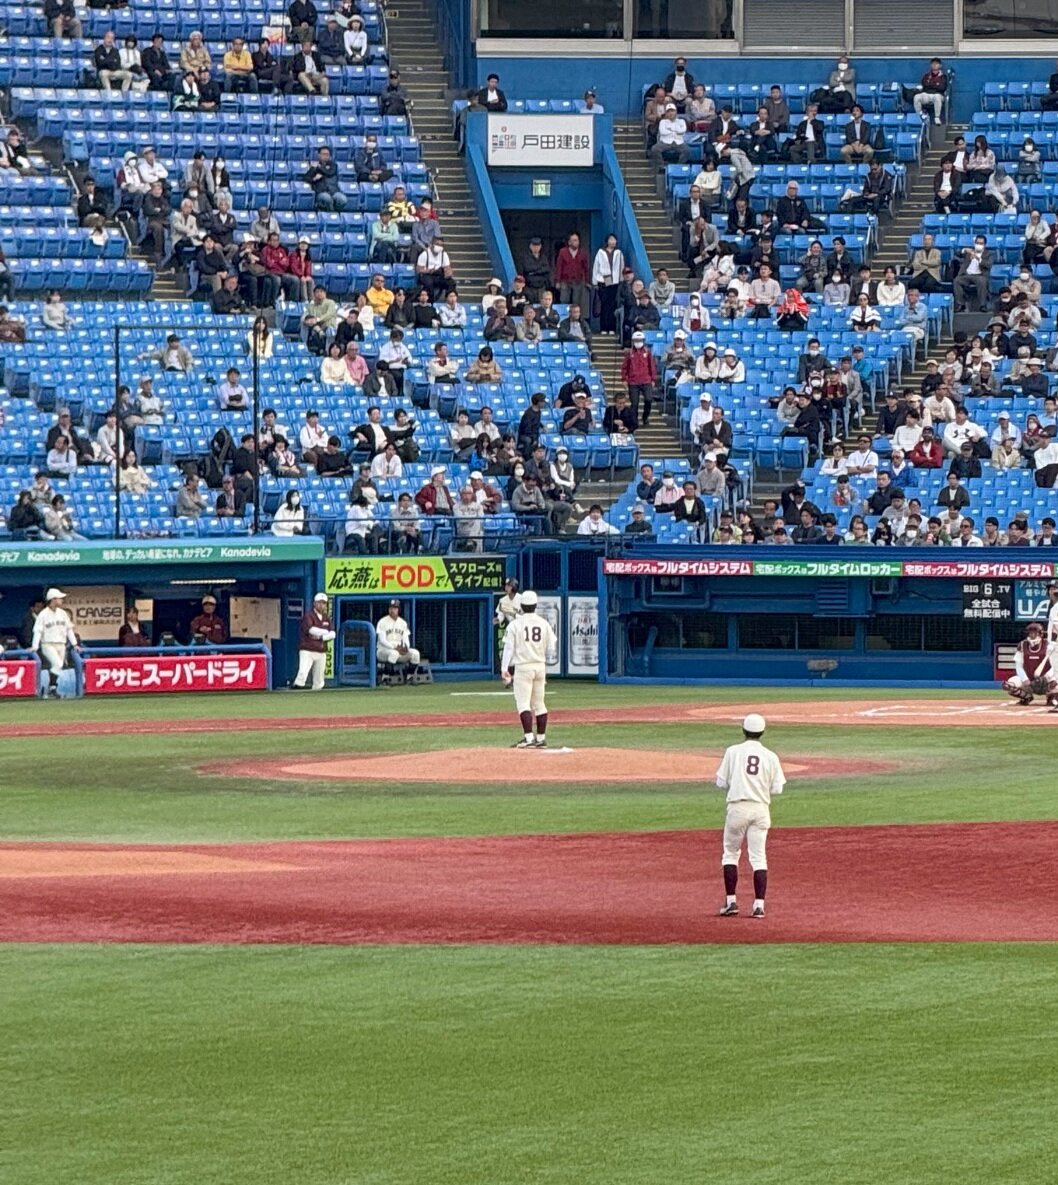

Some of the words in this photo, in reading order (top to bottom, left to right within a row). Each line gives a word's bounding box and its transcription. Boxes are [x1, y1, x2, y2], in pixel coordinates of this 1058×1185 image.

[522, 135, 590, 150] 戸田建設
[27, 549, 80, 562] Kanadevia
[221, 546, 271, 557] Kanadevia
[972, 599, 1000, 608] 全試合
[964, 609, 1010, 619] 無料配信中
[524, 626, 541, 642] 18
[95, 660, 256, 687] アサヒスーパードライ
[746, 755, 760, 776] 8
